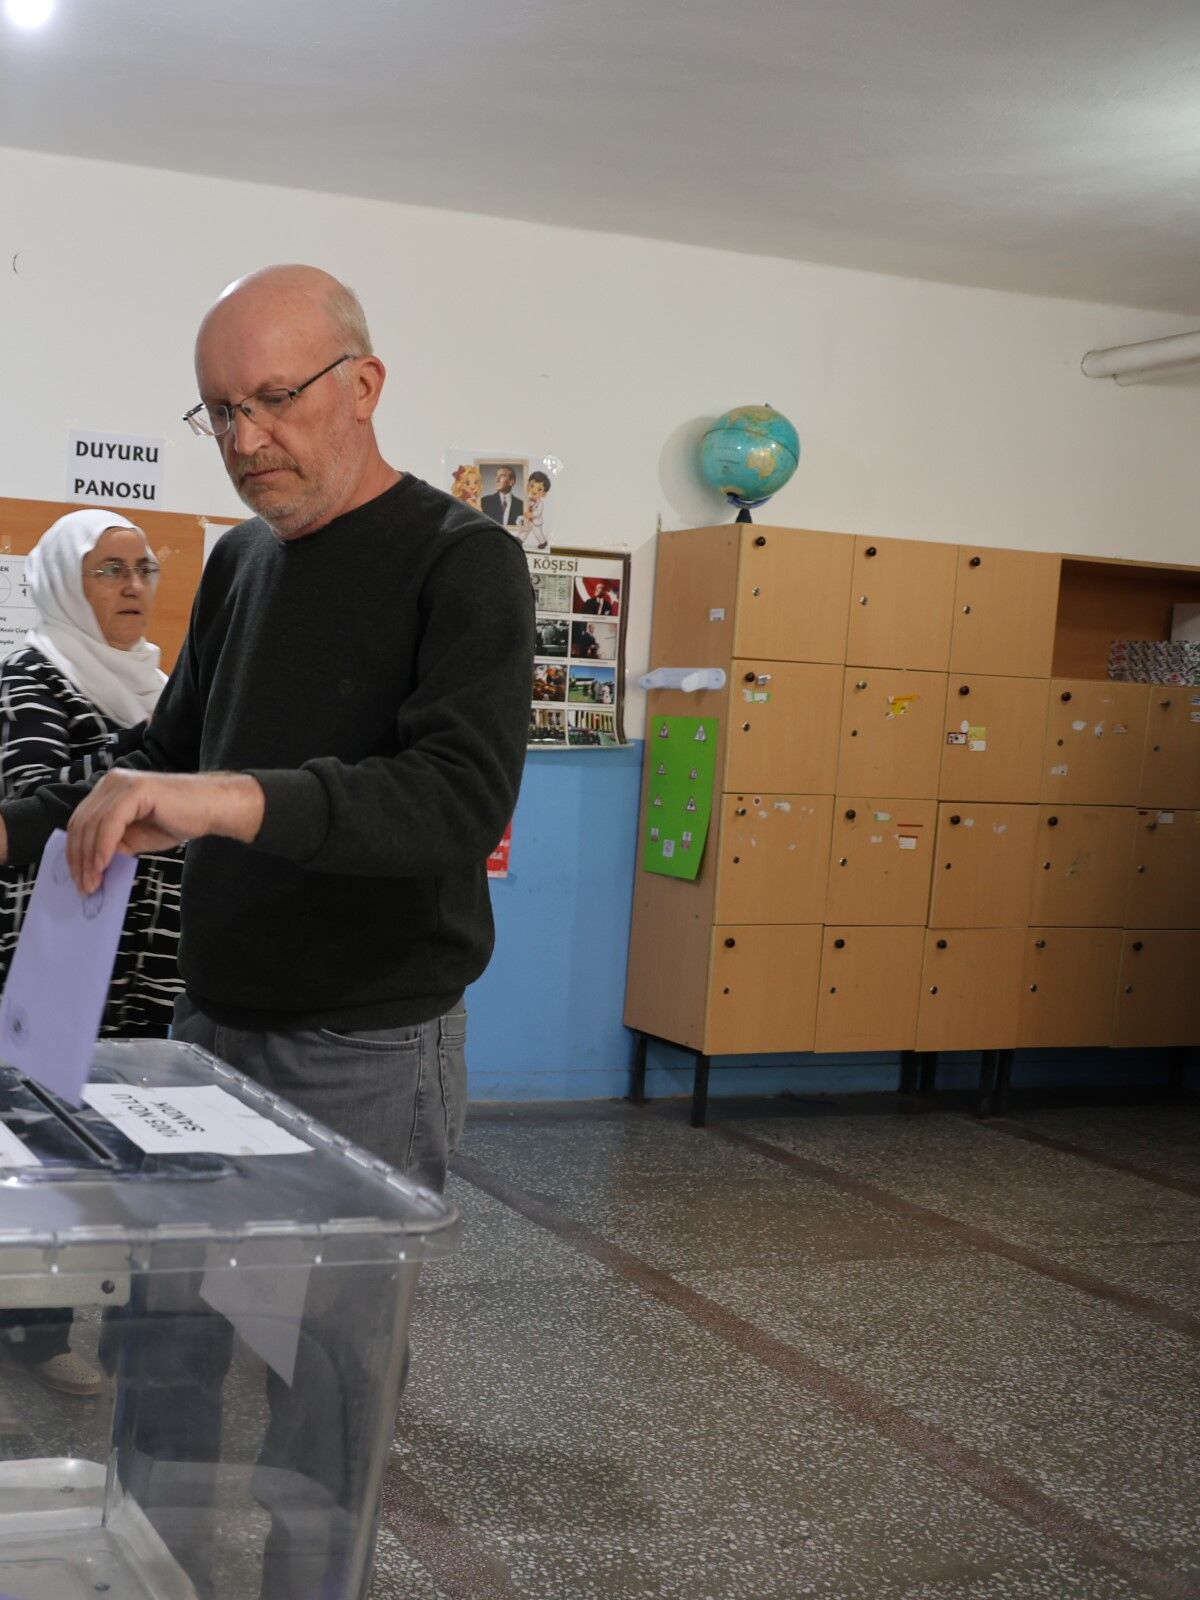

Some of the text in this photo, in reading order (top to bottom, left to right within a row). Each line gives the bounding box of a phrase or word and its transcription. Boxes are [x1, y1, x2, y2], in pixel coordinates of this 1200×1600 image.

[76, 440, 159, 463] DUYURU
[74, 478, 155, 500] PANOSU
[533, 556, 578, 573] KÖŞESİ
[21, 588, 27, 597] 4
[110, 1092, 158, 1118] NOLU
[149, 1100, 207, 1133] SANDIK
